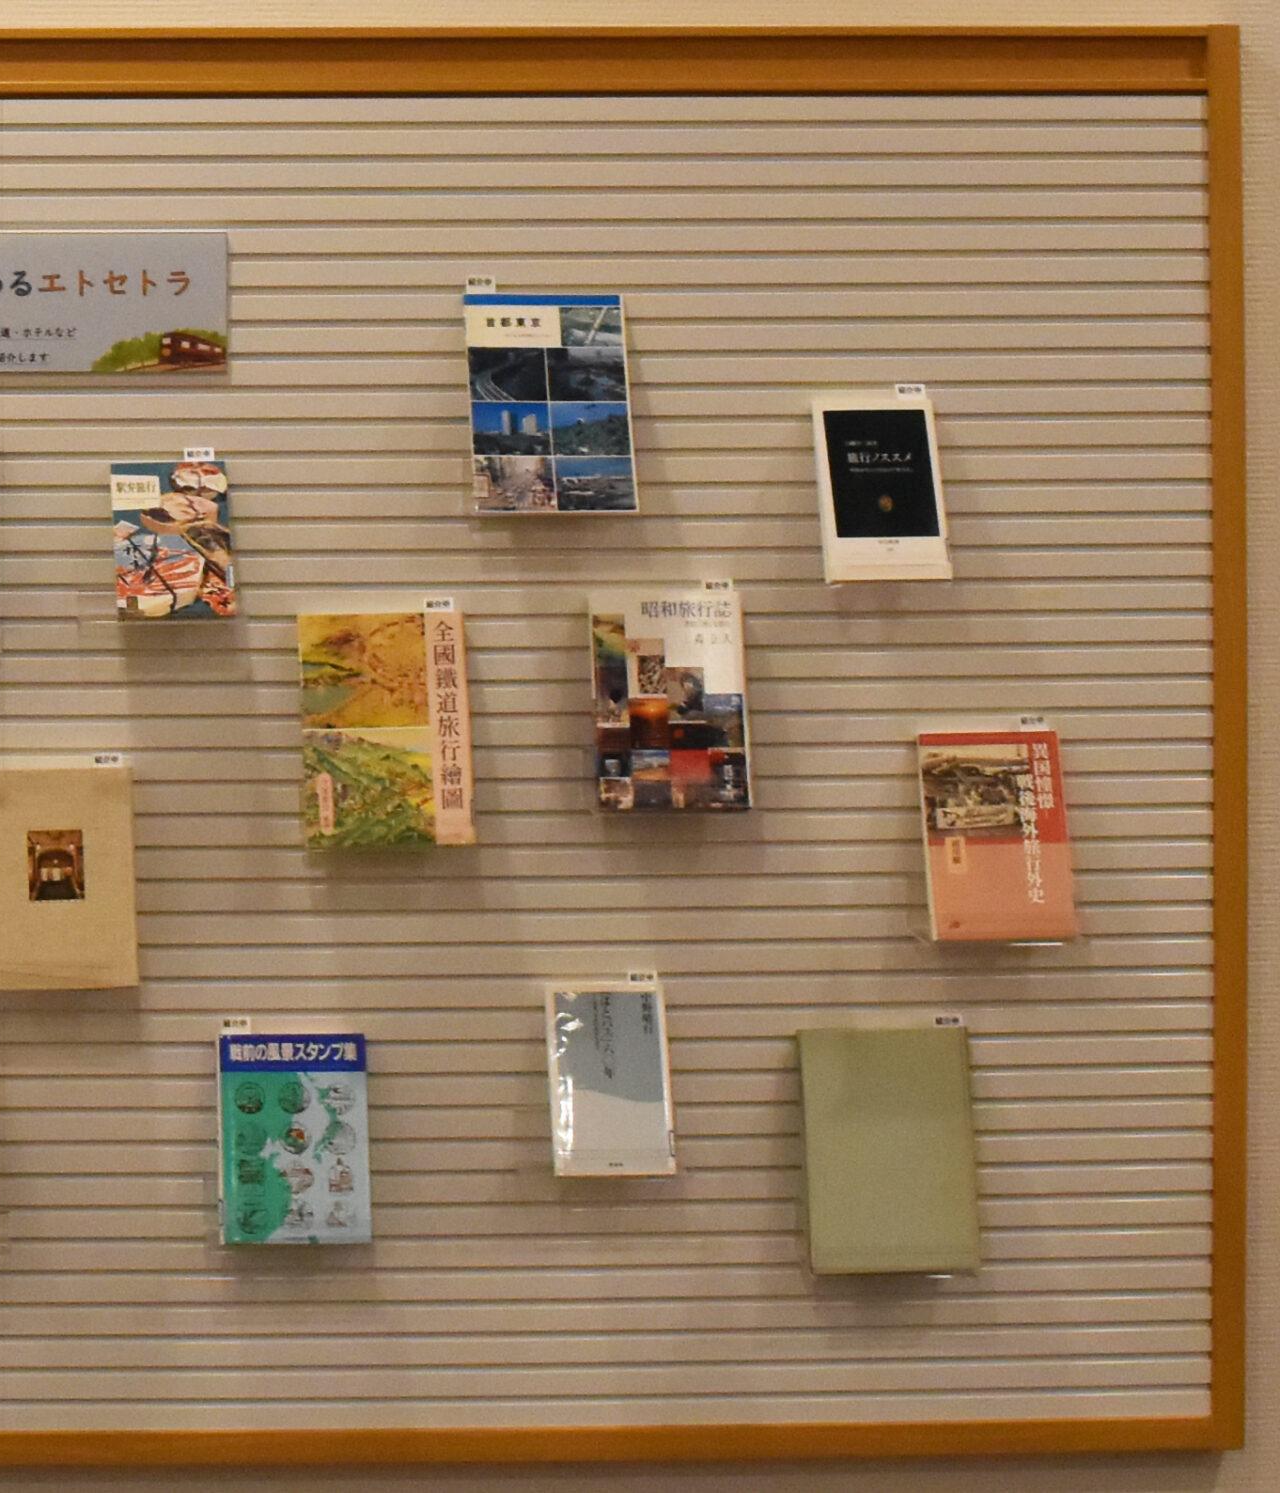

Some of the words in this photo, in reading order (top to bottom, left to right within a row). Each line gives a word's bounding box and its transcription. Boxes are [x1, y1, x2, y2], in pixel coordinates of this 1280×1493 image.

[229, 1043, 358, 1062] 戦前の風景スタンプ集
